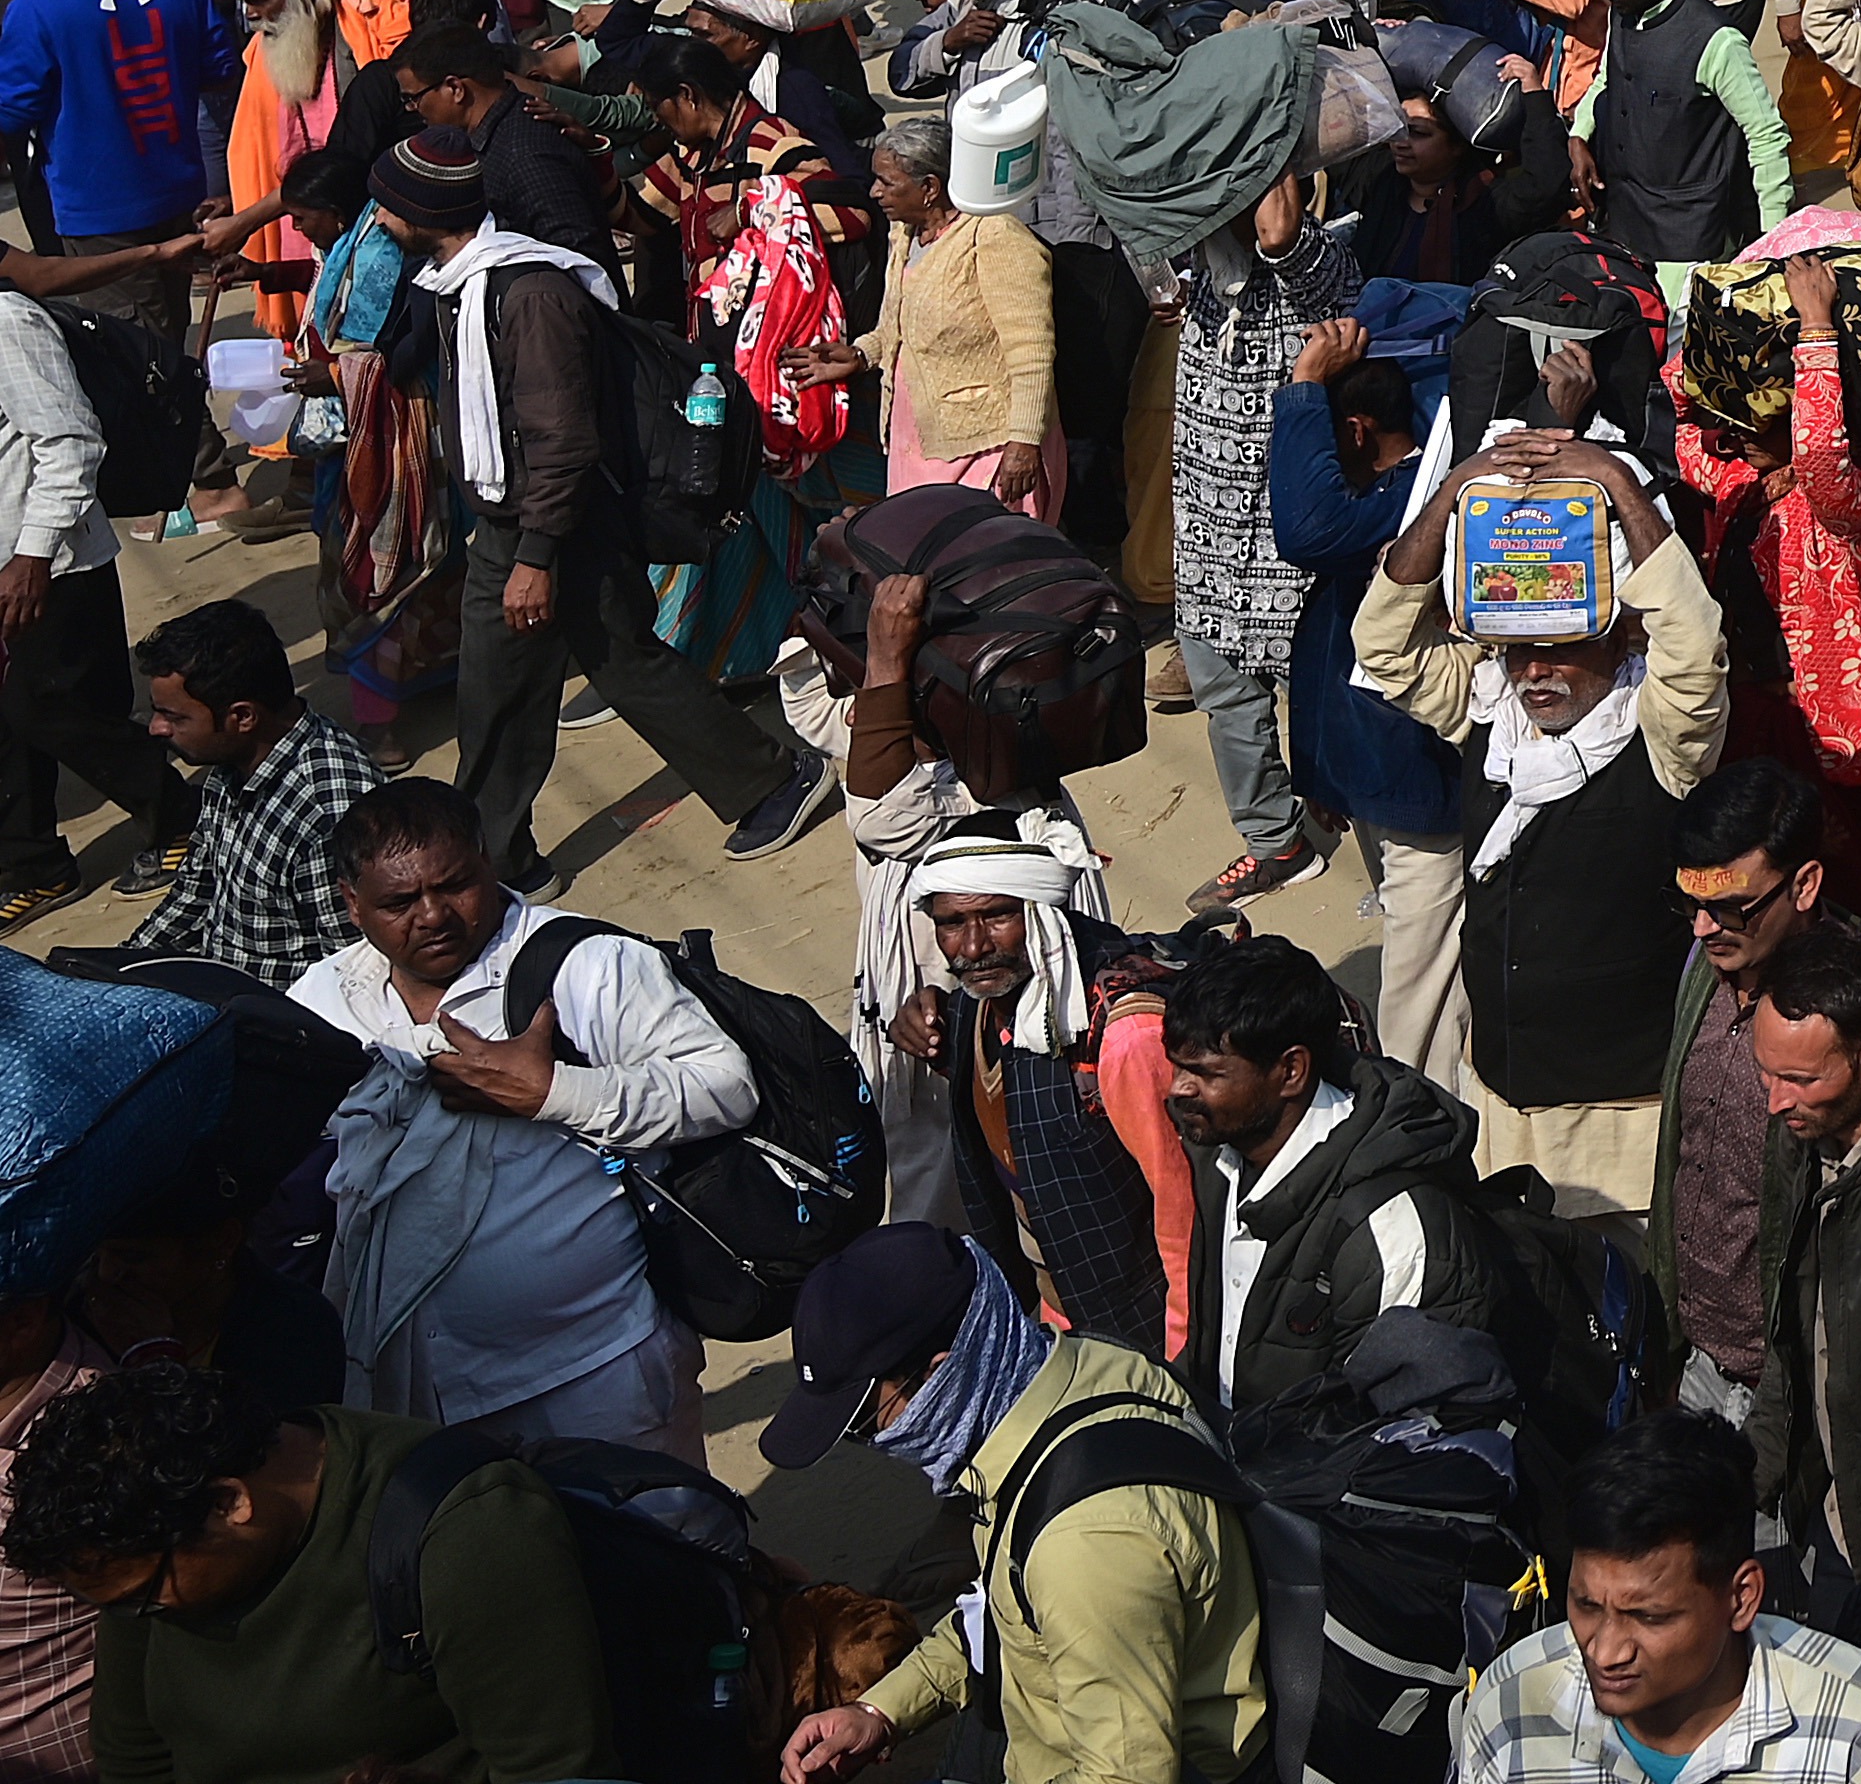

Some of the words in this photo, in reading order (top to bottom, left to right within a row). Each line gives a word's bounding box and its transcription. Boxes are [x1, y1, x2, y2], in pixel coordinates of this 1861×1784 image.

[1494, 527, 1523, 535] SUPER
[1525, 527, 1559, 535] ACTION
[1489, 538, 1529, 550] MONO
[1531, 537, 1564, 550] ZINC
